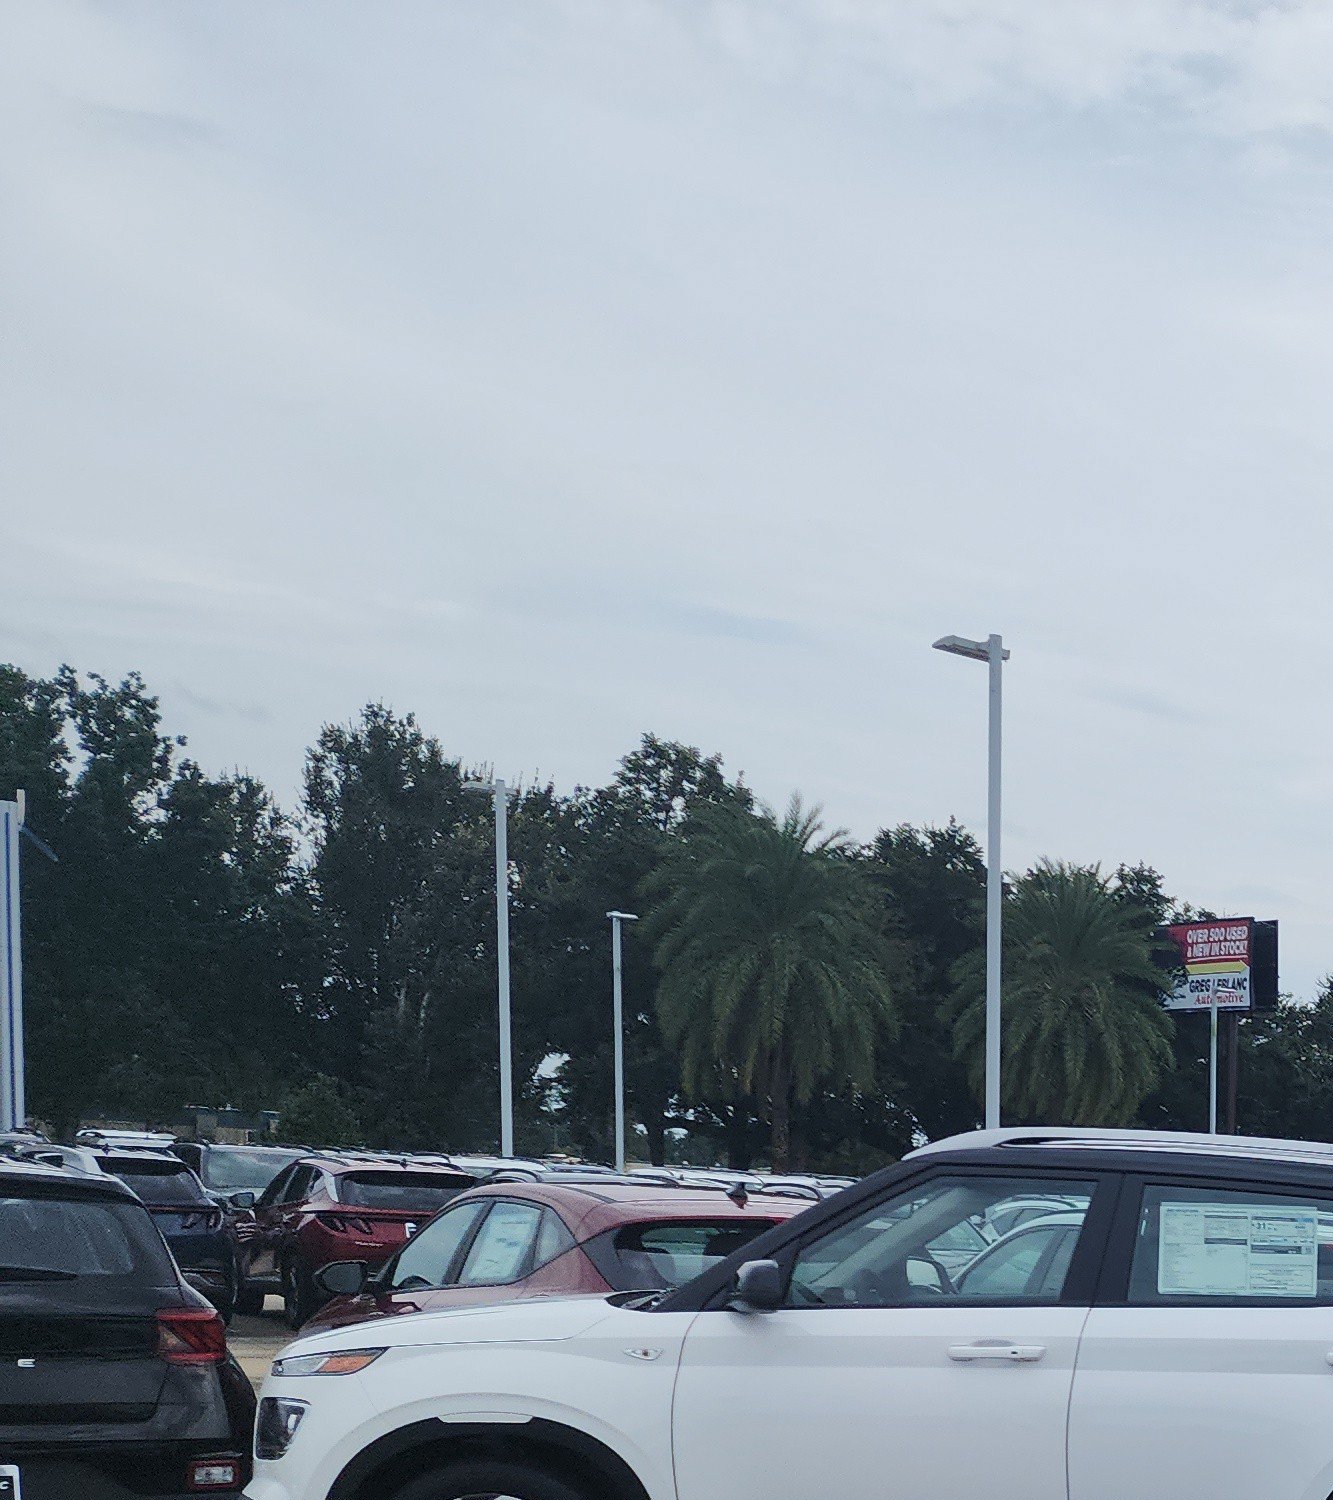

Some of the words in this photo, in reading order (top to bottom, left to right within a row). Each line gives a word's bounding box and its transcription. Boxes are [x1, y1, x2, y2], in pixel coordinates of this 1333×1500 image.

[1186, 928, 1209, 944] OVER
[1226, 926, 1248, 941] USED
[1193, 943, 1211, 958] NEW
[1211, 942, 1220, 956] IN
[1189, 979, 1211, 994] GREG
[1194, 992, 1245, 1005] Autmotive
